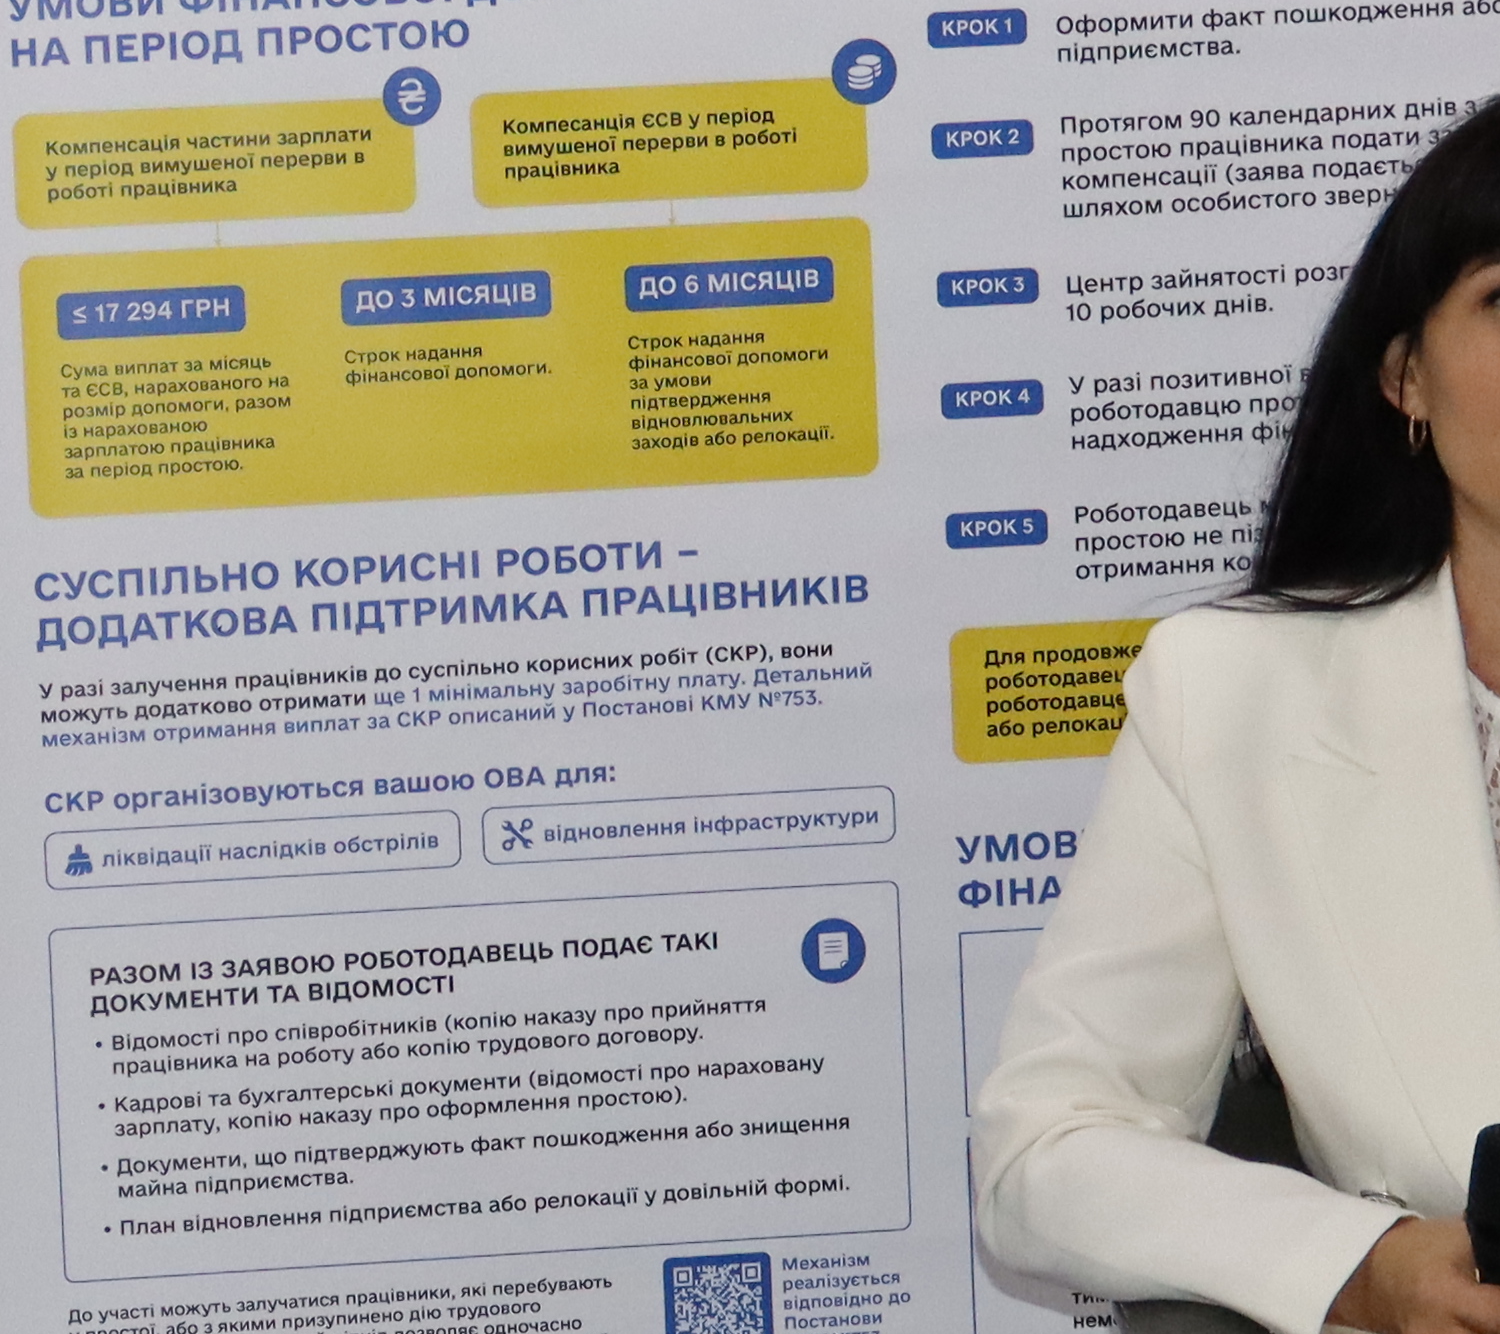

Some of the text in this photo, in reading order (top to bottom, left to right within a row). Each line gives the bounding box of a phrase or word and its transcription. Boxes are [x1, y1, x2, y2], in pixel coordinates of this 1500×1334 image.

[942, 18, 1011, 36] КРОК 1
[11, 18, 470, 67] НА ПЕРІОД ПРОСТОЮ
[946, 128, 1019, 147] КРОК 2
[639, 269, 819, 299] ДО 6 МІСЯЦІВ
[952, 277, 1024, 295] КРОК 3
[95, 302, 119, 322] 17
[127, 301, 172, 321] 294
[181, 298, 229, 318] ГРН
[356, 283, 536, 314] ДО 3 МІСЯЦІВ
[956, 388, 1030, 407] КРОК 4
[961, 518, 1034, 537] КРОК 5
[35, 561, 279, 601] СУСПІЛЬНО
[295, 550, 479, 588] КОРИСНІ
[497, 541, 662, 577] РОБОТИ
[37, 575, 869, 652] ДОДАТКОВА ПІДТРИМКА ПРАЦІВНИКІВ
